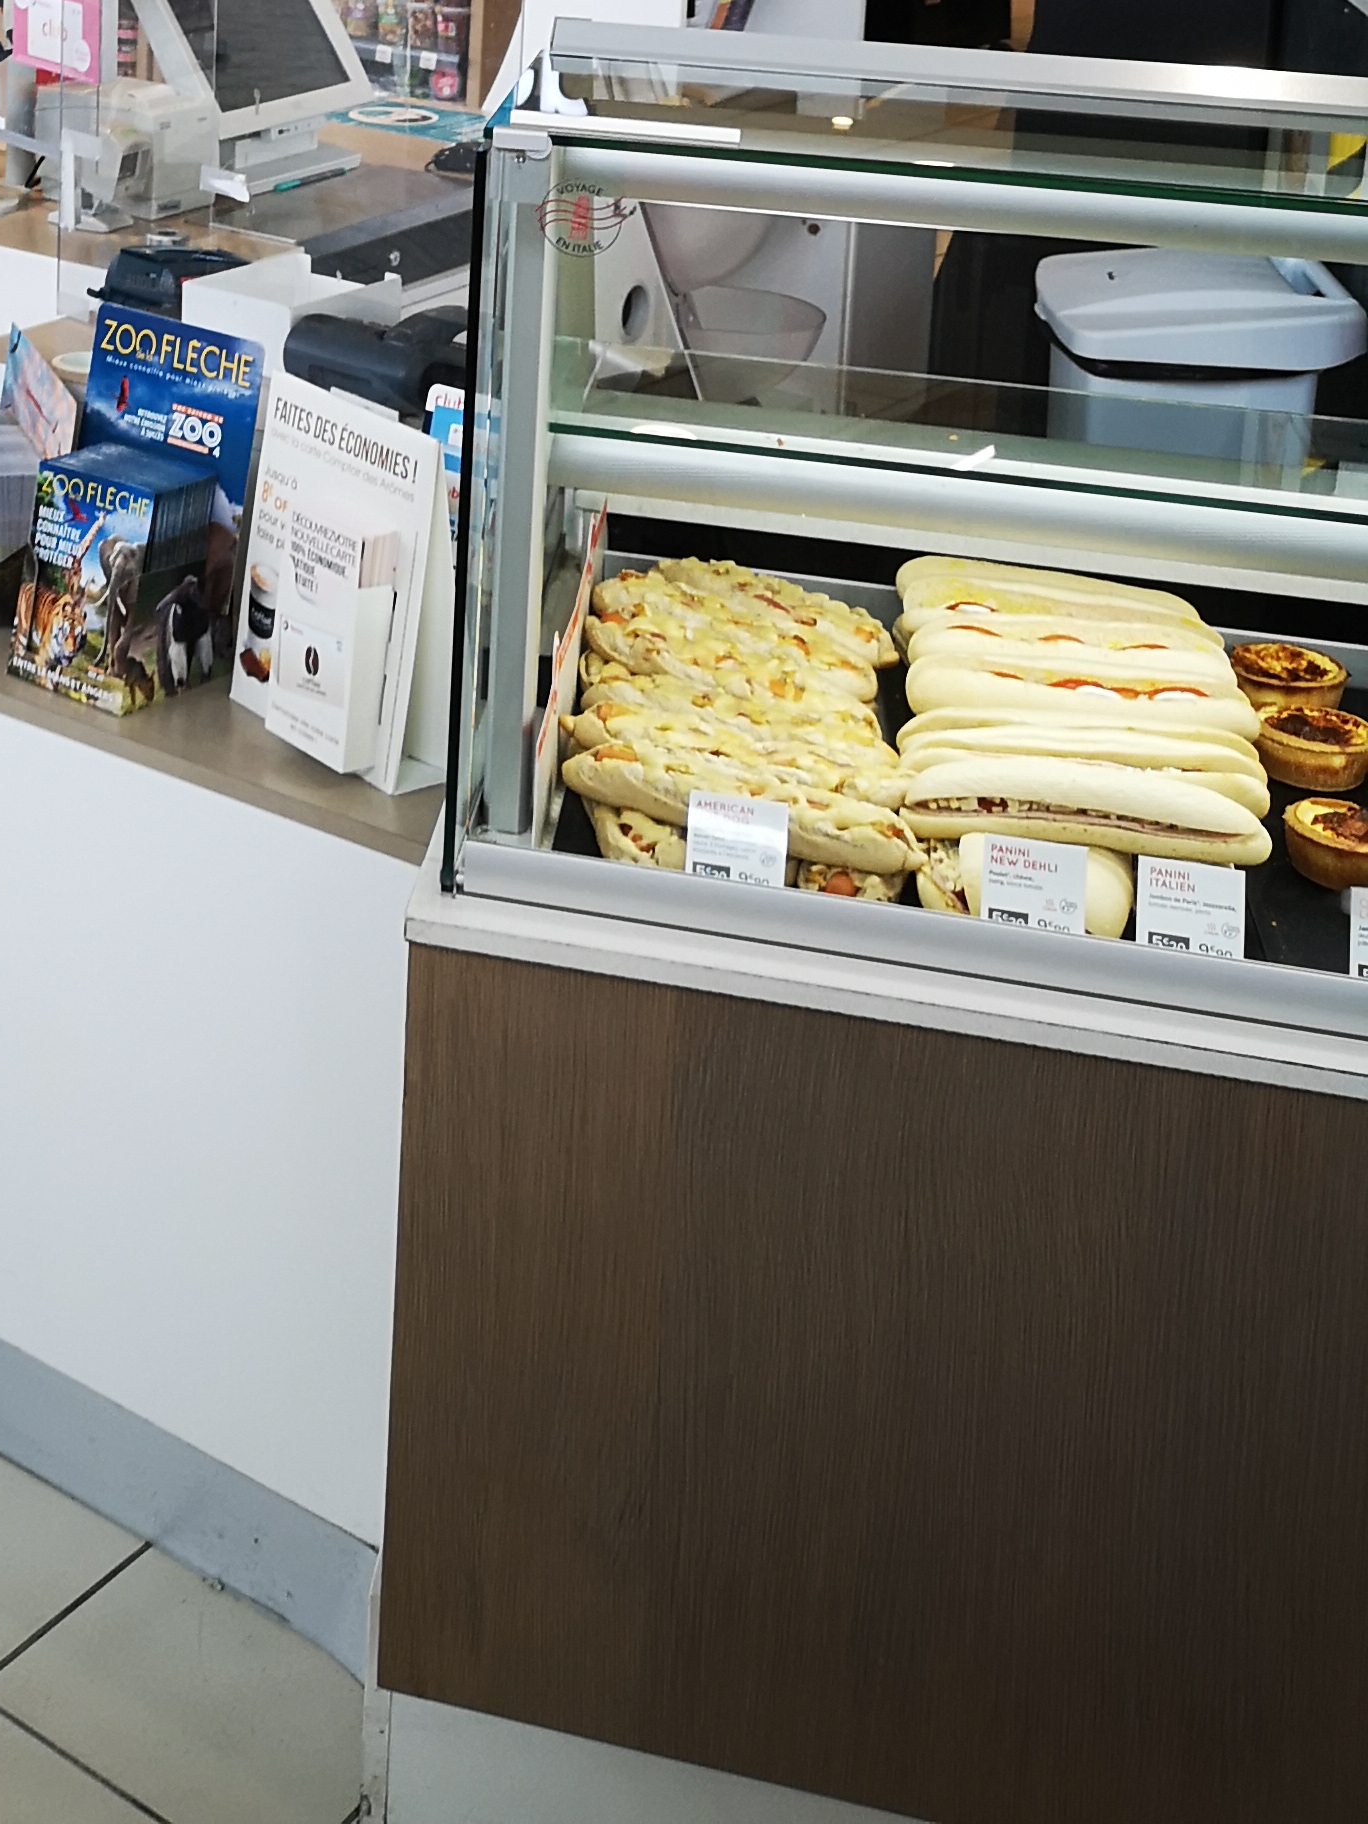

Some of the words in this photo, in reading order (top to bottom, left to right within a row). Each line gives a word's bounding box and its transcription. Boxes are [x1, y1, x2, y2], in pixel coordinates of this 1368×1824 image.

[556, 183, 604, 197] VOYAGE
[555, 236, 570, 250] EN
[572, 239, 604, 253] ITALIE
[100, 319, 157, 356] ZOO
[165, 370, 182, 382] pour
[168, 411, 222, 448] ZOO
[274, 397, 314, 435] FAITES
[313, 415, 336, 447] DES
[338, 423, 410, 480] ÉCONOMIES
[412, 460, 418, 484] !
[212, 446, 220, 459] 4
[42, 470, 85, 502] ZOO
[258, 509, 279, 530] pour
[34, 532, 57, 549] POUR
[696, 799, 755, 816] AMERICAN
[991, 843, 1030, 857] PANINI
[990, 854, 1019, 866] NEW
[1023, 859, 1058, 873] DEHLI
[1150, 866, 1190, 881] PANINI
[1149, 878, 1195, 893] ITALIEN
